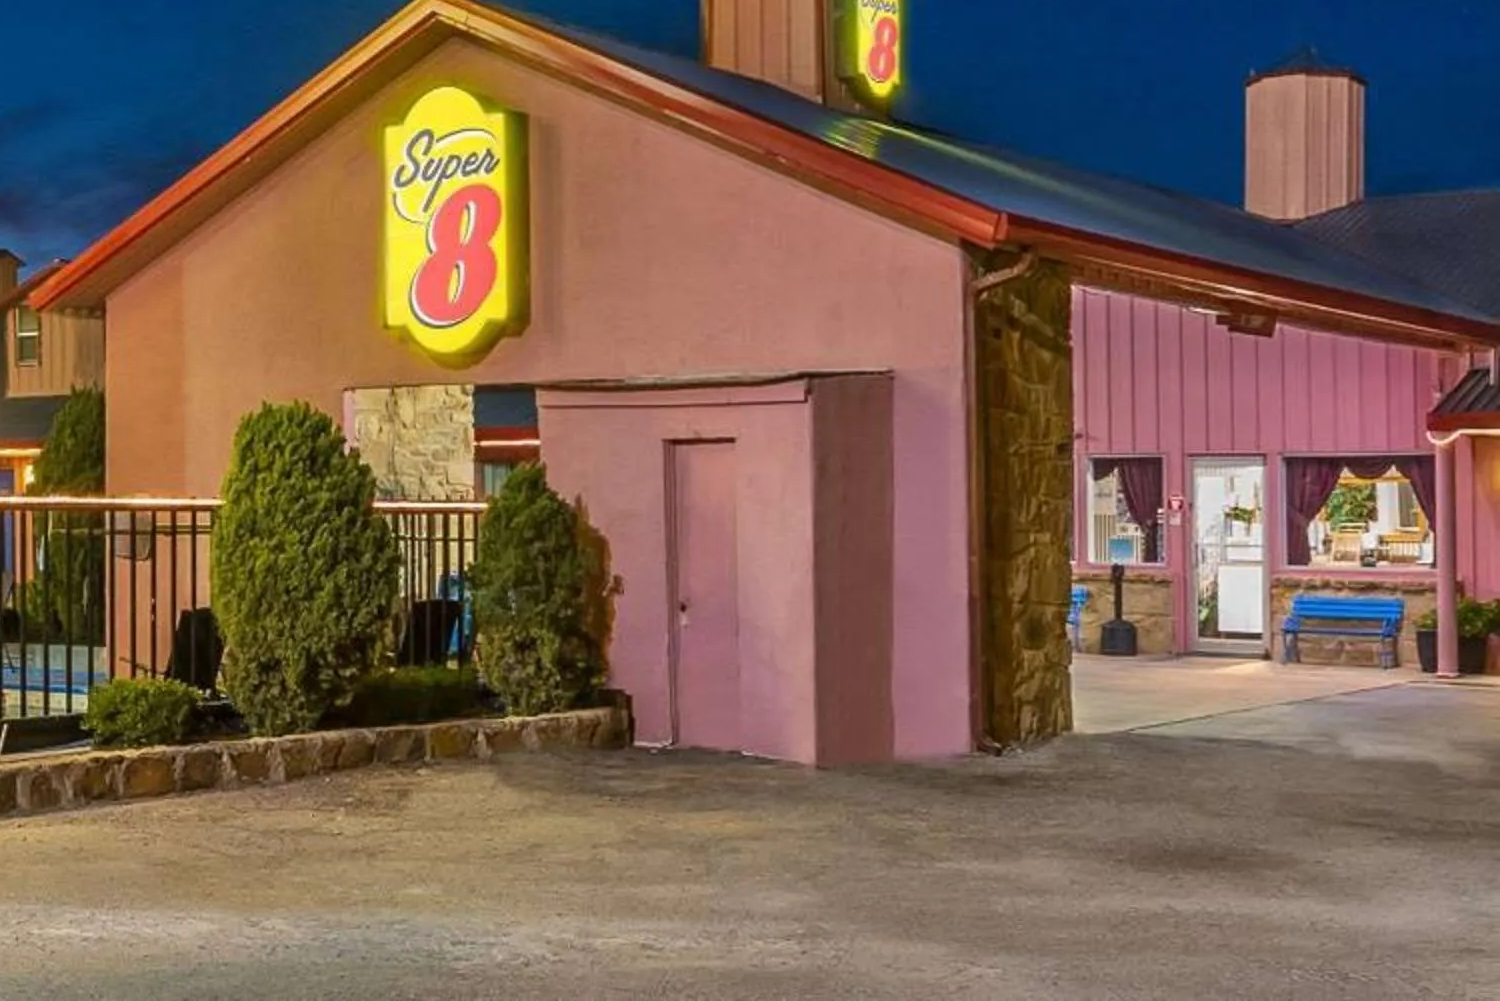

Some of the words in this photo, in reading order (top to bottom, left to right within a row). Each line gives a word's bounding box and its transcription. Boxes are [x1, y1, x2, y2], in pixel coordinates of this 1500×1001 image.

[868, 16, 898, 83] 8
[393, 128, 500, 213] Super
[409, 183, 502, 329] 8
